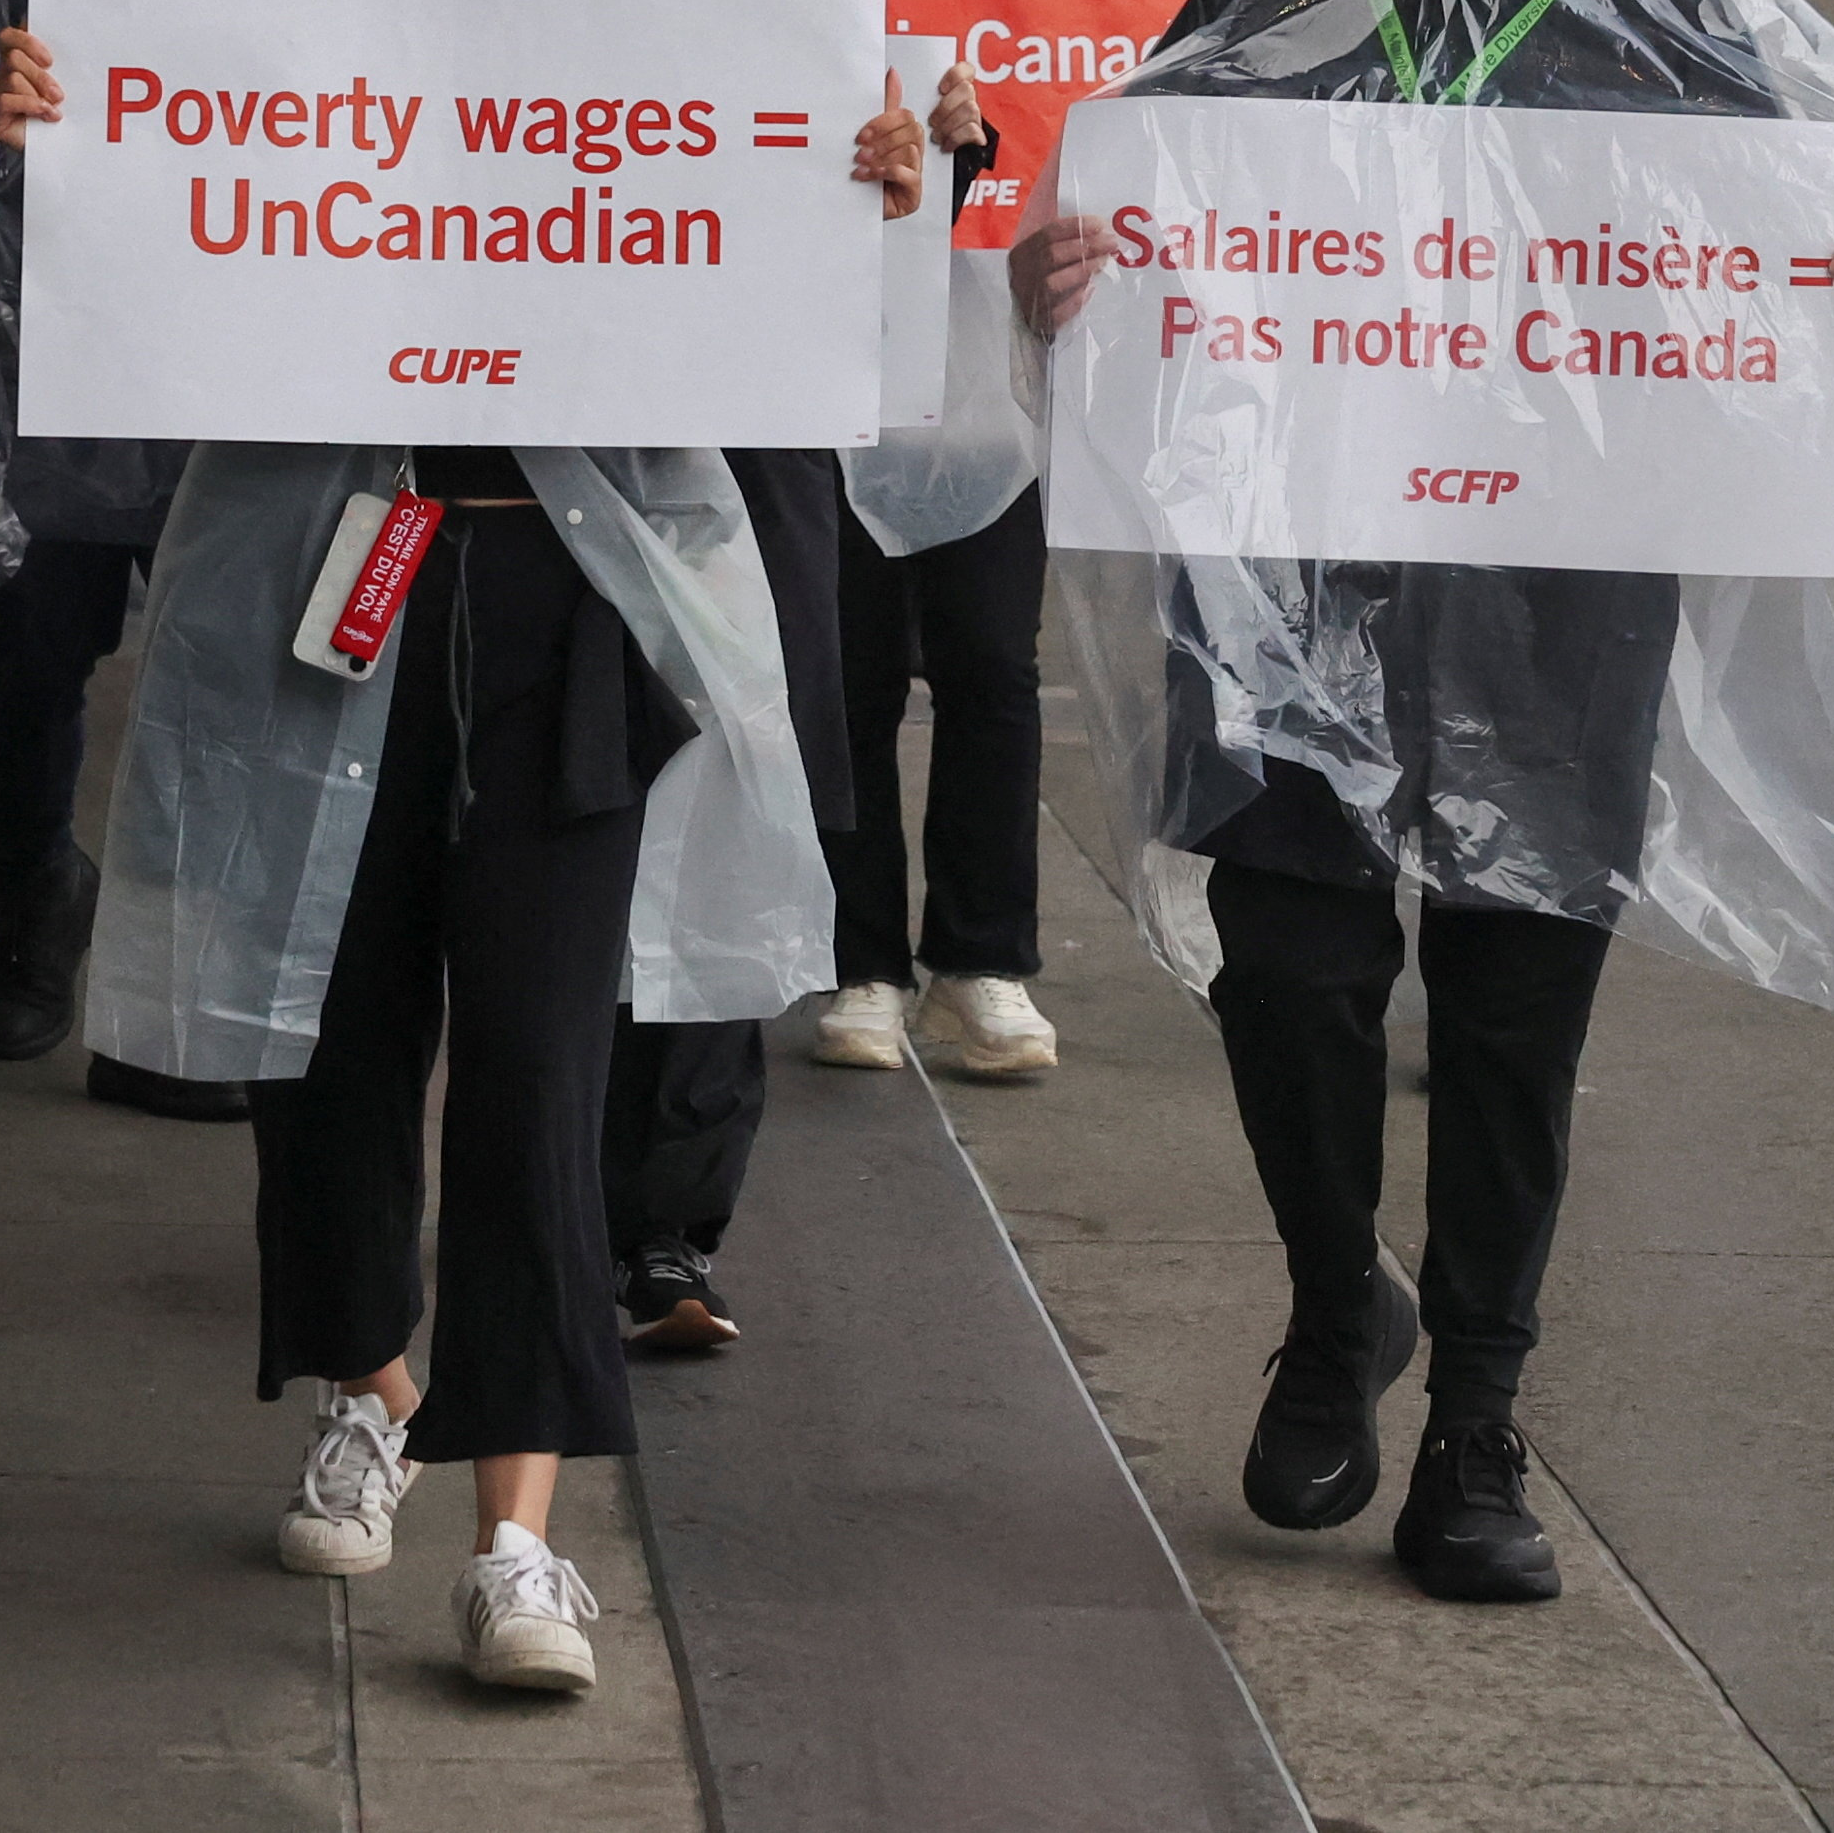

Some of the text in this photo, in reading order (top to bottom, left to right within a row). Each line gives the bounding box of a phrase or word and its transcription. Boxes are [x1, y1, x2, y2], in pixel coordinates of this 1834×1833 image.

[107, 67, 422, 170] Poverty
[457, 97, 717, 174] wages
[192, 178, 721, 265] UnCanadian
[1112, 206, 1385, 278] Salaires
[1415, 217, 1495, 281] de
[1527, 222, 1761, 293] misère
[390, 347, 522, 385] CUPE
[1160, 297, 1778, 383] Pas notre Canada
[1403, 467, 1520, 505] SCFP
[383, 508, 415, 556] C'EST
[354, 583, 381, 614] VOL
[370, 515, 429, 623] TRAVAIL NON PAYÉ
[372, 555, 393, 583] DU
